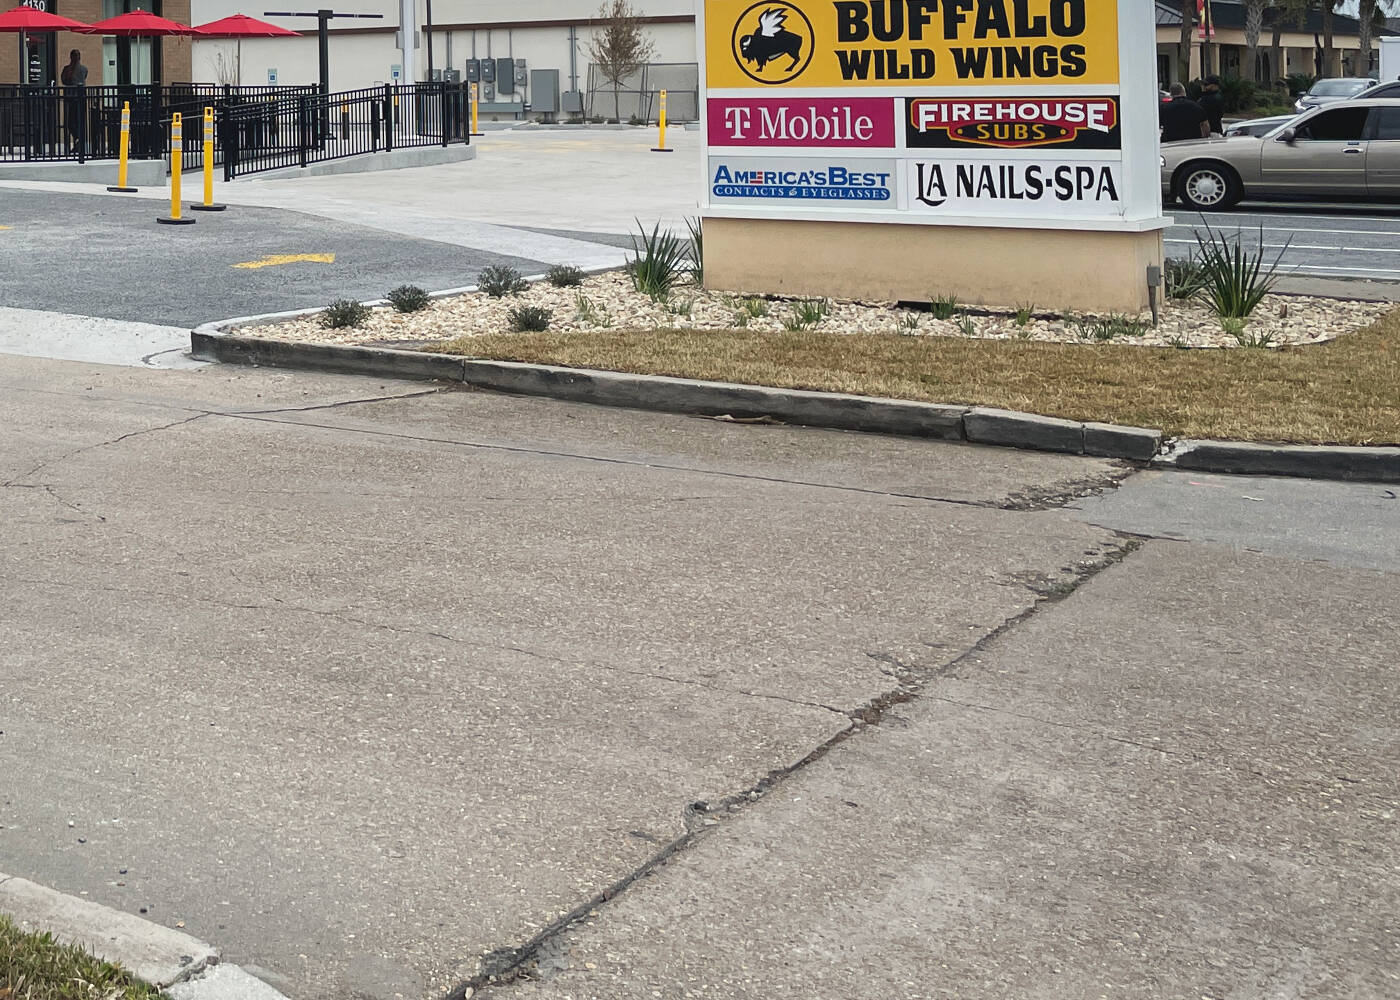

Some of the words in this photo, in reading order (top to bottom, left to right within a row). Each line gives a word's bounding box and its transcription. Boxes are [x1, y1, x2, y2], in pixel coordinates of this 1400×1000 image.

[834, 48, 937, 81] WILD
[950, 44, 1087, 79] WINGS
[758, 106, 874, 141] Mobile
[918, 103, 1110, 134] FIREHOUSE
[976, 124, 1047, 140] SUBS
[715, 186, 785, 196] CONTACTS
[802, 188, 888, 199] EYEGLASSES
[915, 163, 948, 207] LA
